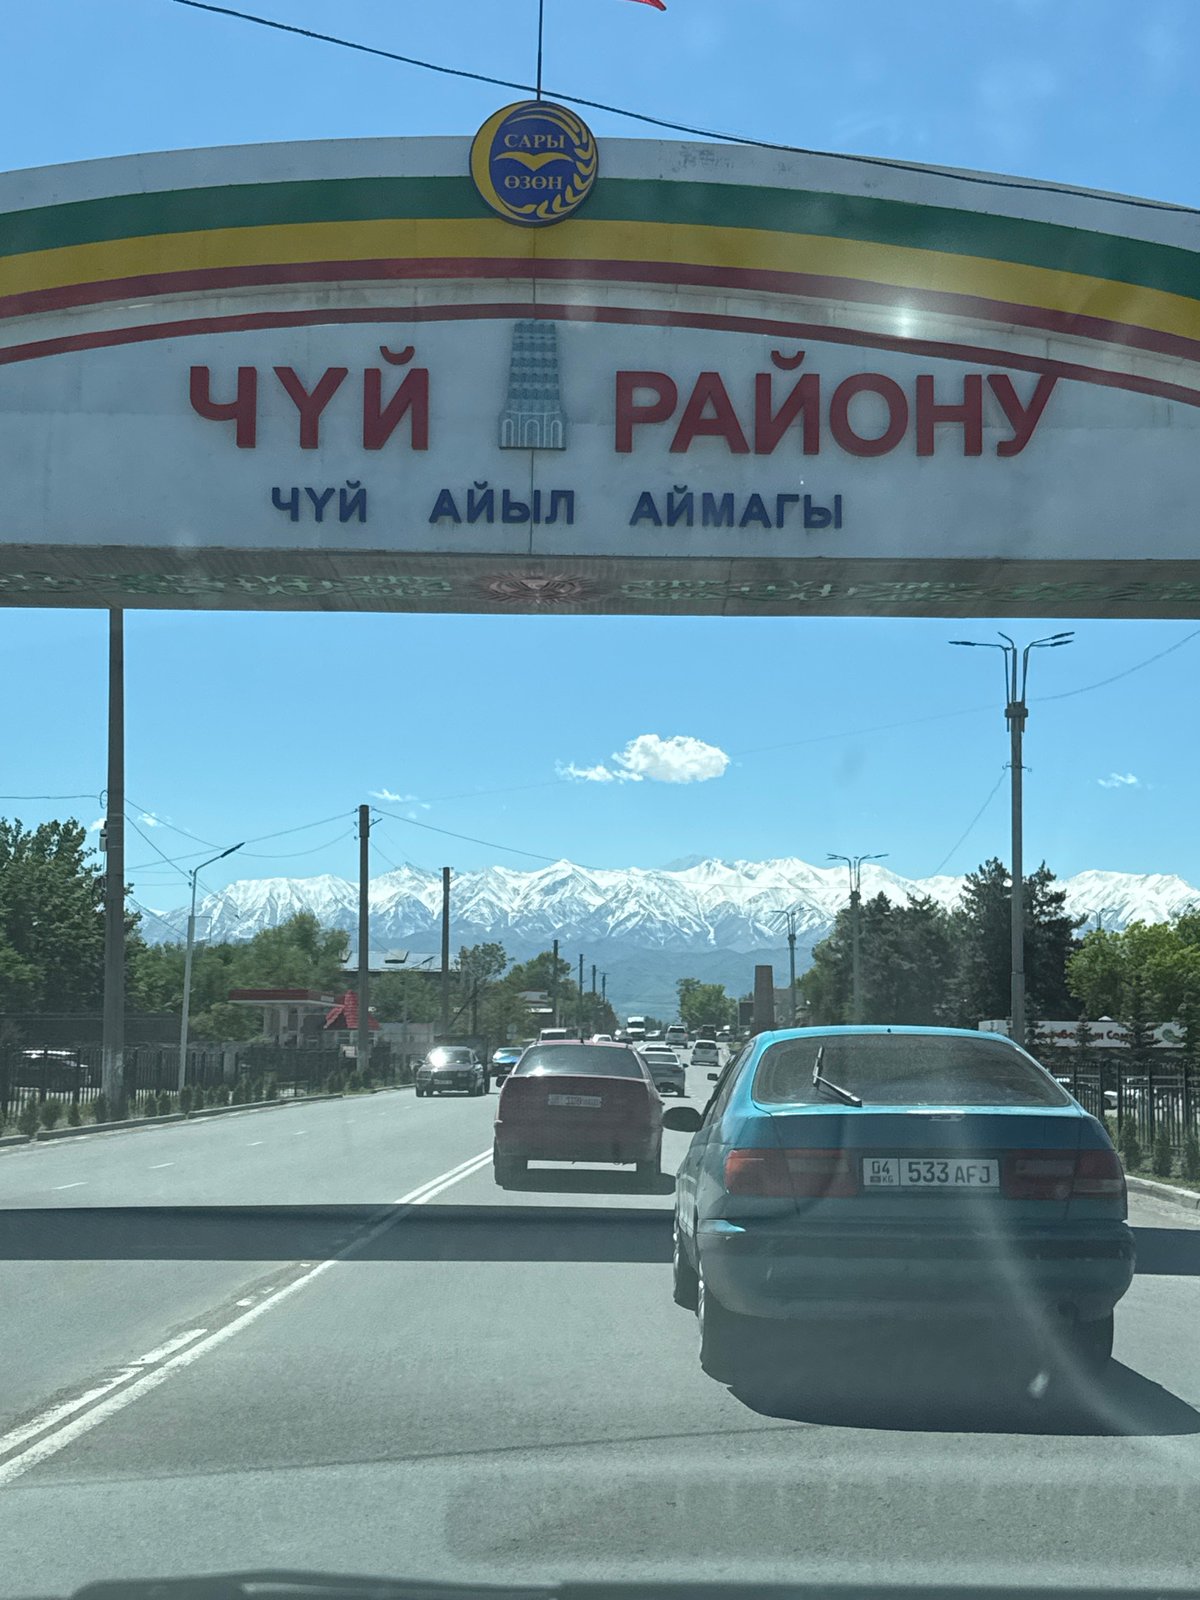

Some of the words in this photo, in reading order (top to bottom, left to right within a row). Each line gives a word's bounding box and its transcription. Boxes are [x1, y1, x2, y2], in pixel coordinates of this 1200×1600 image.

[504, 134, 565, 149] САРЫ
[504, 175, 563, 190] ӨЗӨН
[189, 345, 430, 450] ЧҮЙ
[614, 350, 1059, 457] РАЙОНУ
[271, 479, 368, 523] ЧҮЙ
[428, 480, 575, 525] АЙЫЛ
[629, 484, 843, 529] АЙМАГЫ
[871, 1160, 890, 1174] 04
[908, 1161, 949, 1183] 533
[955, 1166, 990, 1183] AFJ
